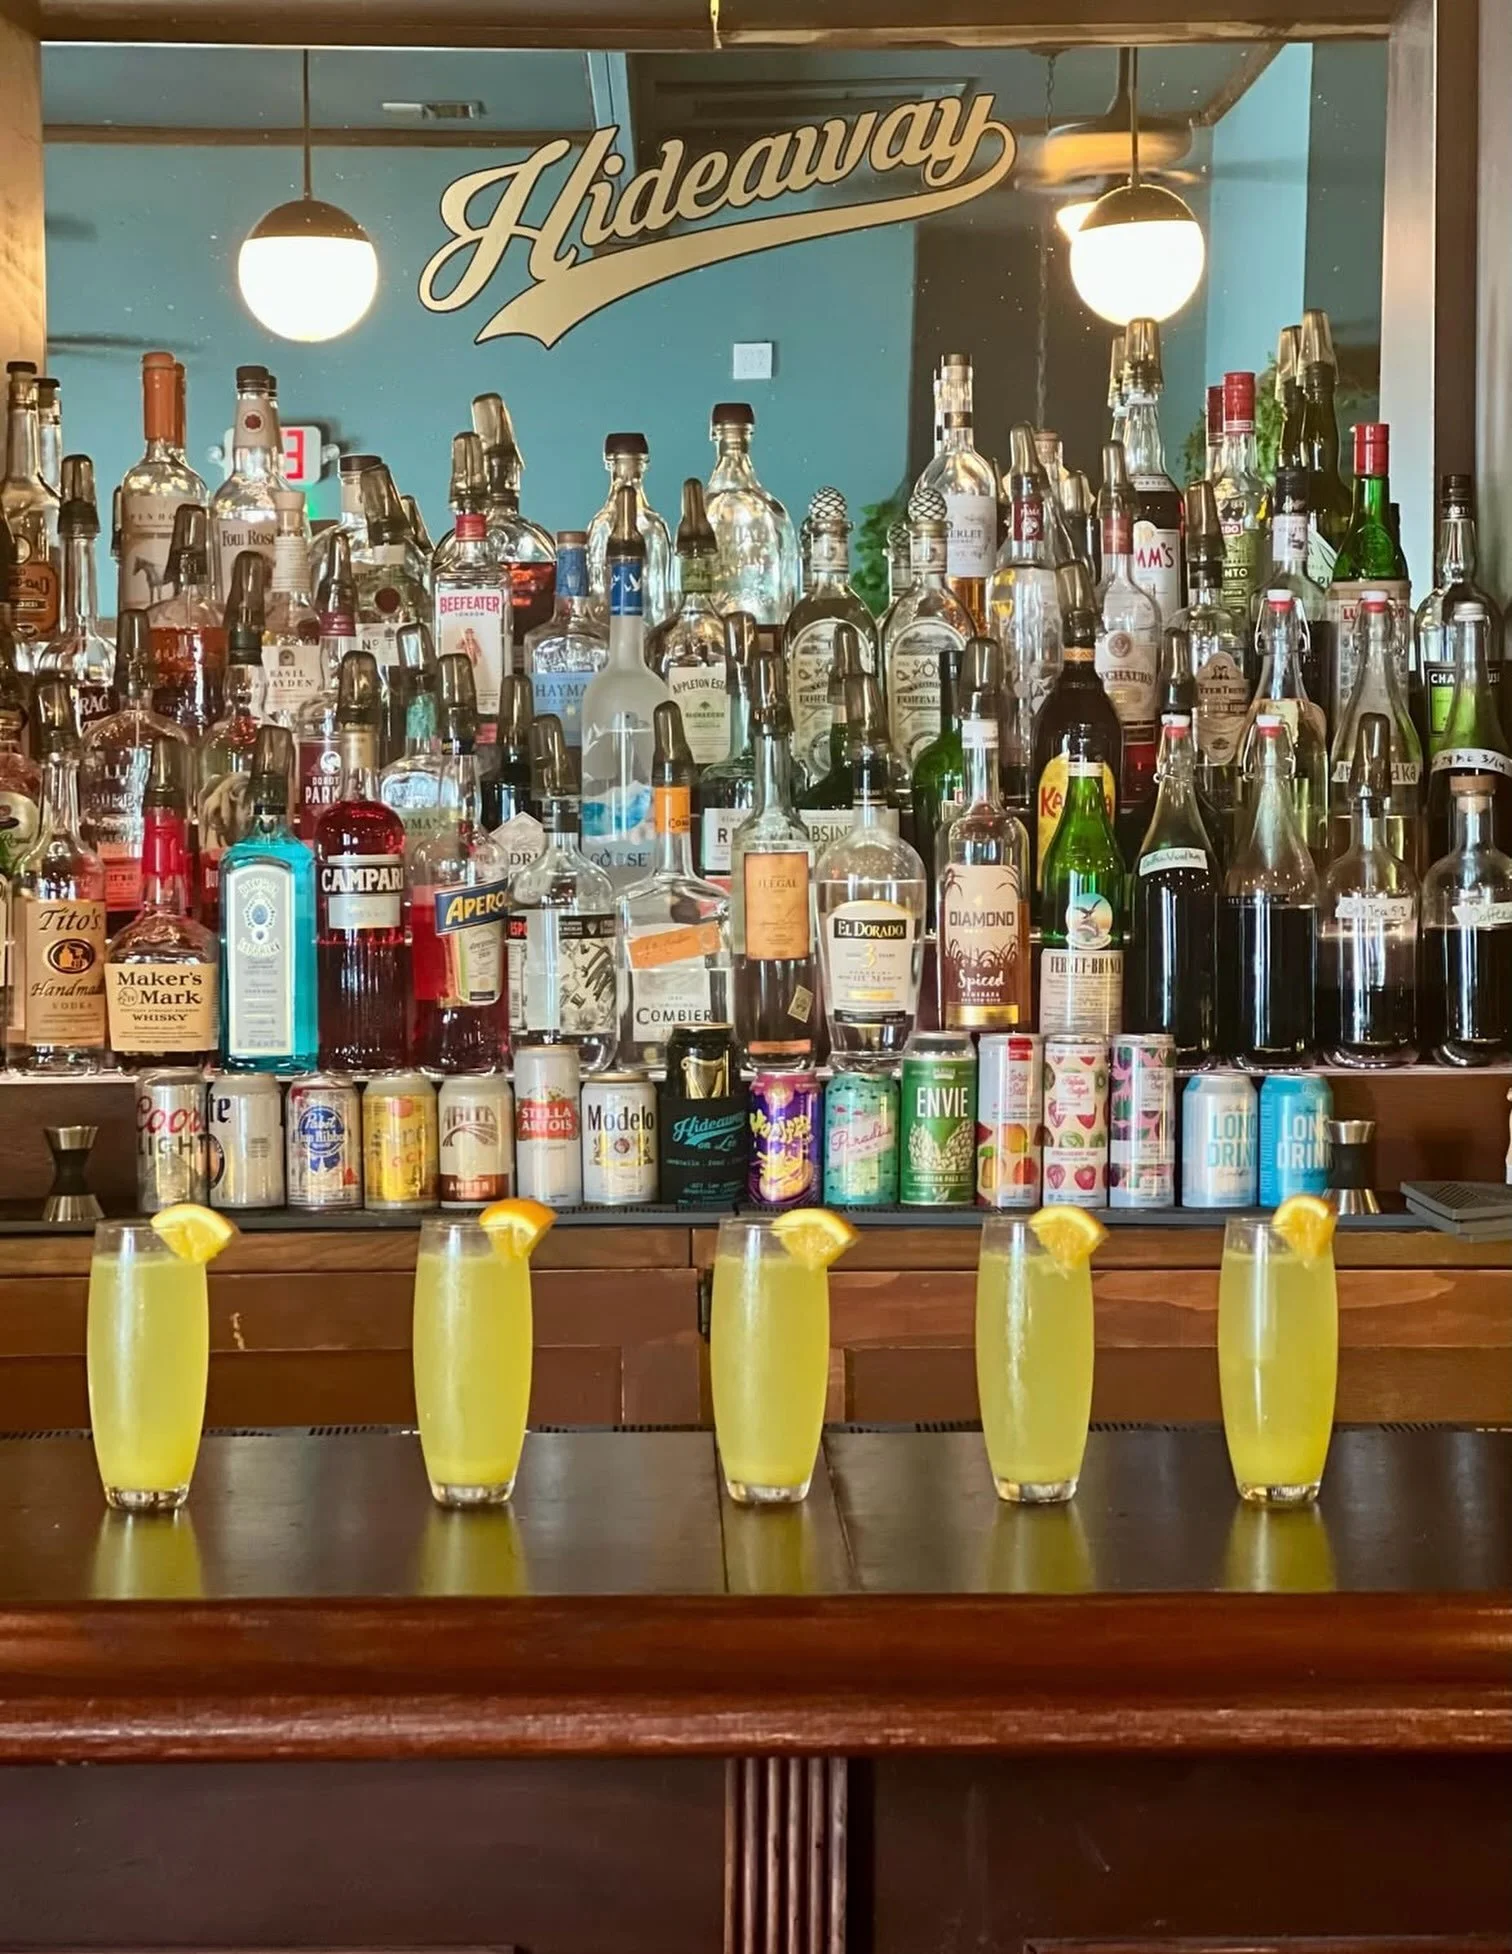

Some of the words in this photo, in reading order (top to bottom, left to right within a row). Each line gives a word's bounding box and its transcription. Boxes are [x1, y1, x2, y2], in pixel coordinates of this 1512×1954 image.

[418, 92, 1016, 313] Hideaway
[440, 596, 500, 614] BEEFEATER
[672, 679, 709, 694] APPLETON
[39, 906, 101, 931] Tito's
[949, 911, 1014, 927] DIAMOND
[838, 920, 852, 936] EL
[853, 921, 904, 937] DORADO
[117, 971, 203, 986] Maker's
[957, 969, 1005, 992] Spiced
[139, 990, 203, 1005] Mark
[636, 1007, 714, 1025] COMBIER
[916, 1087, 968, 1118] ENVIE
[521, 1107, 572, 1119] STELLA
[587, 1104, 654, 1132] Modelo
[521, 1119, 573, 1132] ARTOIS
